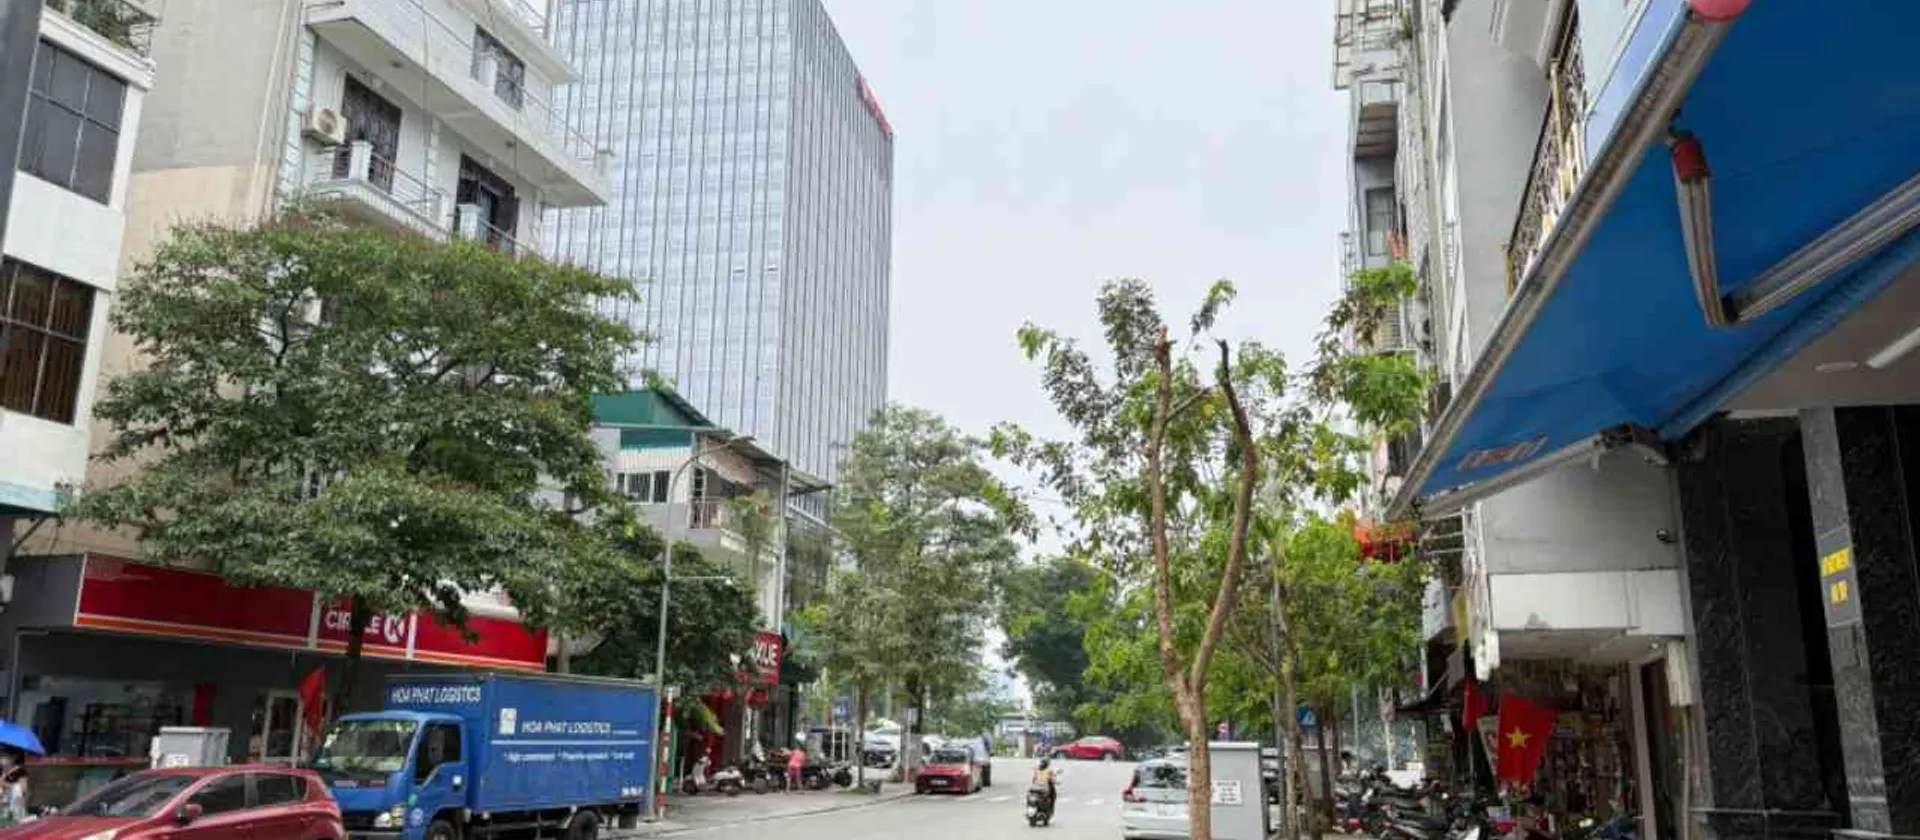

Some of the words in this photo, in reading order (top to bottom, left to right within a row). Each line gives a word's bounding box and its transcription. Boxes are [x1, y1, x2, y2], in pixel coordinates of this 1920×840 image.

[434, 685, 481, 703] LOGISTICS
[521, 720, 542, 733] HOA
[568, 721, 611, 734] LOGISTICS
